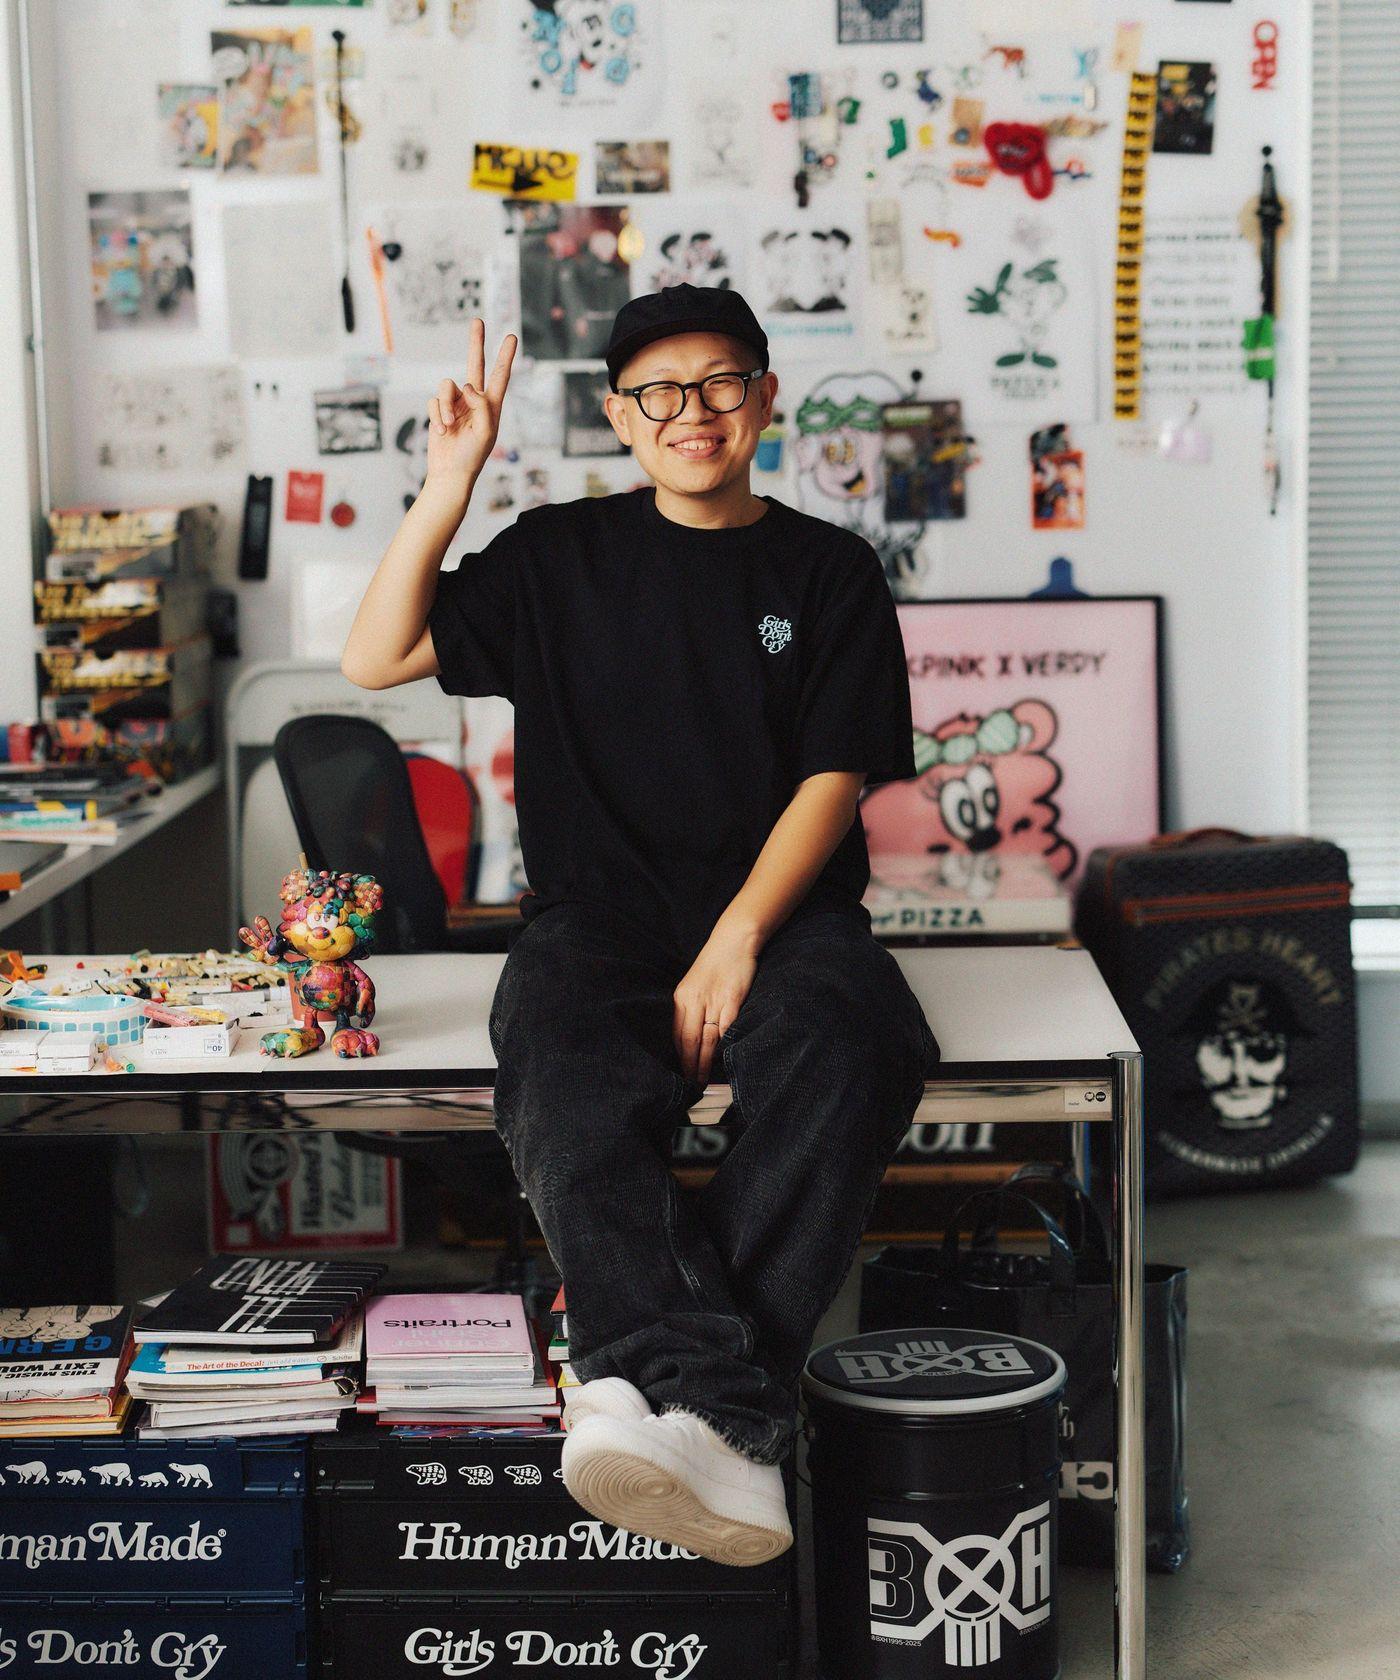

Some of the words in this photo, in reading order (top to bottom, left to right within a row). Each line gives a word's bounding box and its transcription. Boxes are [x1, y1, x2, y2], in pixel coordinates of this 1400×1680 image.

[763, 615, 791, 632] Girls
[762, 635, 787, 653] Cry
[901, 908, 984, 928] PIZZA
[383, 1319, 512, 1328] Portraits
[50, 1362, 101, 1371] EXIT
[202, 1362, 214, 1370] Art
[215, 1361, 224, 1369] of
[225, 1361, 238, 1369] the
[239, 1359, 265, 1368] Decal:
[5, 1371, 58, 1379] MUSIC
[398, 1521, 568, 1570] Human
[27, 1628, 140, 1665] Don't
[150, 1632, 227, 1680] Cry
[404, 1627, 495, 1677] Girls
[505, 1629, 620, 1666] Don't
[630, 1632, 708, 1680] Cry
